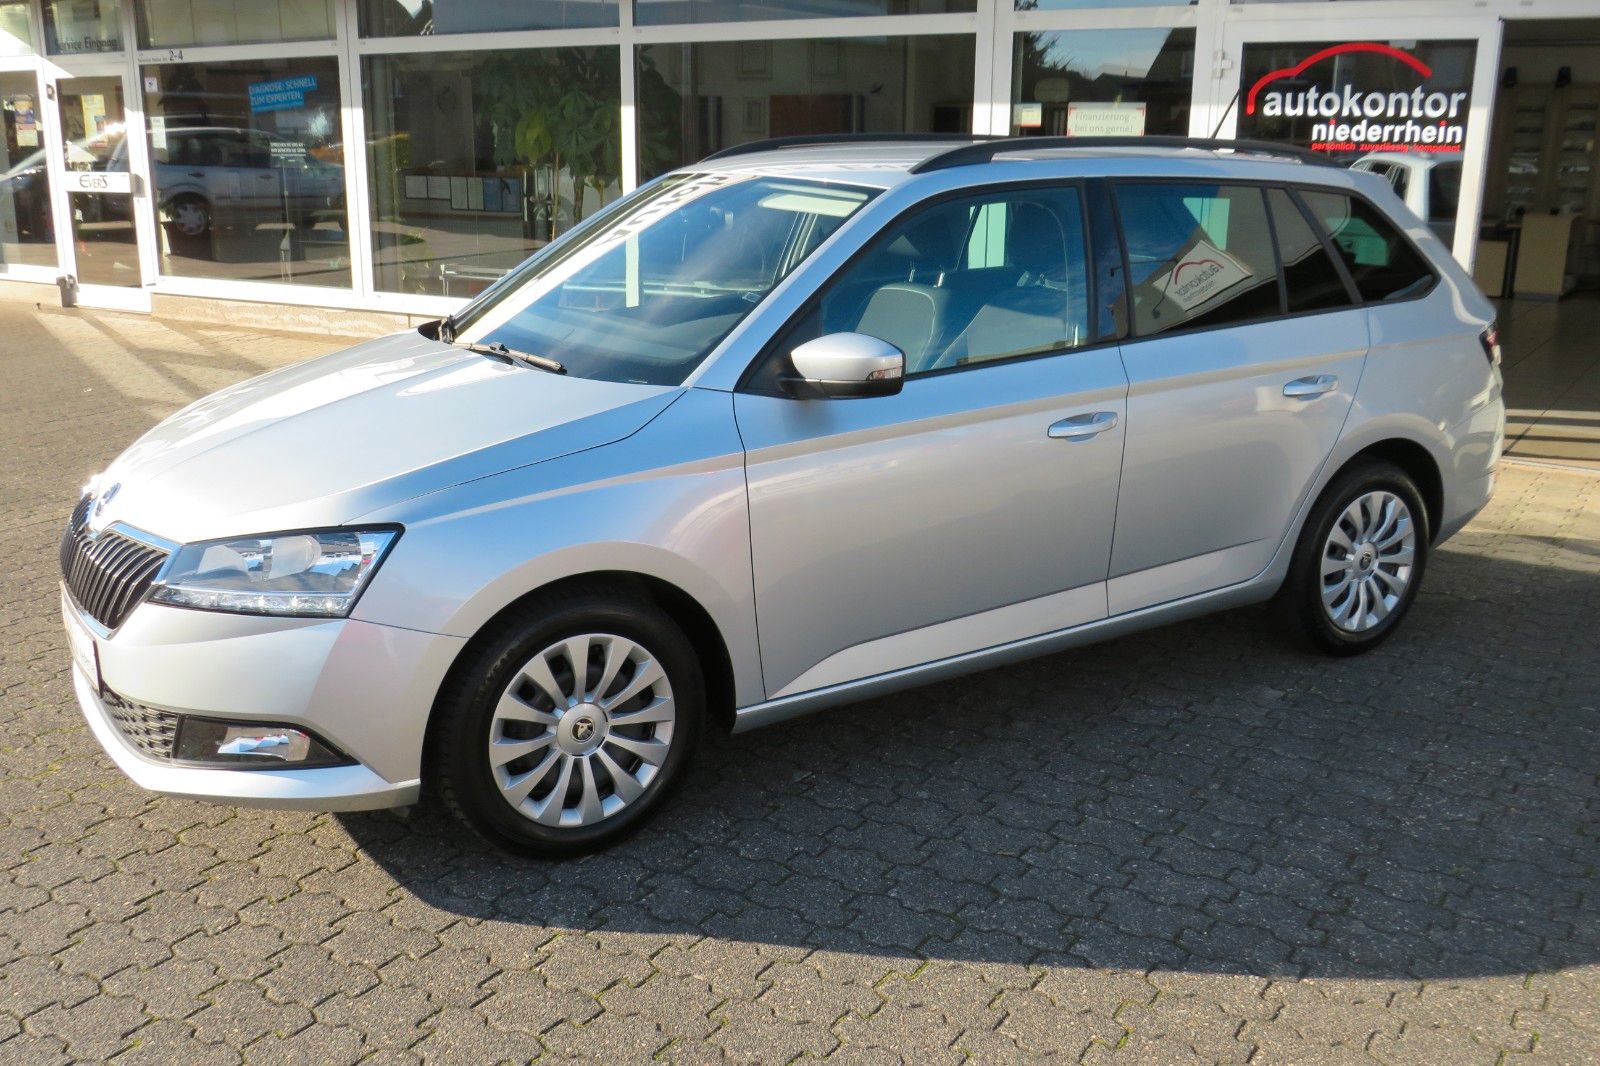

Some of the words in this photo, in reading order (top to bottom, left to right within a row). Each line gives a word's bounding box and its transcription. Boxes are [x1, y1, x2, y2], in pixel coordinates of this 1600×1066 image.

[169, 49, 184, 60] 2-4
[286, 77, 317, 90] SCHNELL
[250, 95, 265, 106] ZUM
[1262, 84, 1467, 118] autokontor
[1075, 112, 1130, 122] Finanzierung
[1074, 124, 1087, 132] bei
[1105, 124, 1133, 134] gerne!
[1311, 118, 1463, 143] niederrhein
[1311, 142, 1356, 151] persönlich
